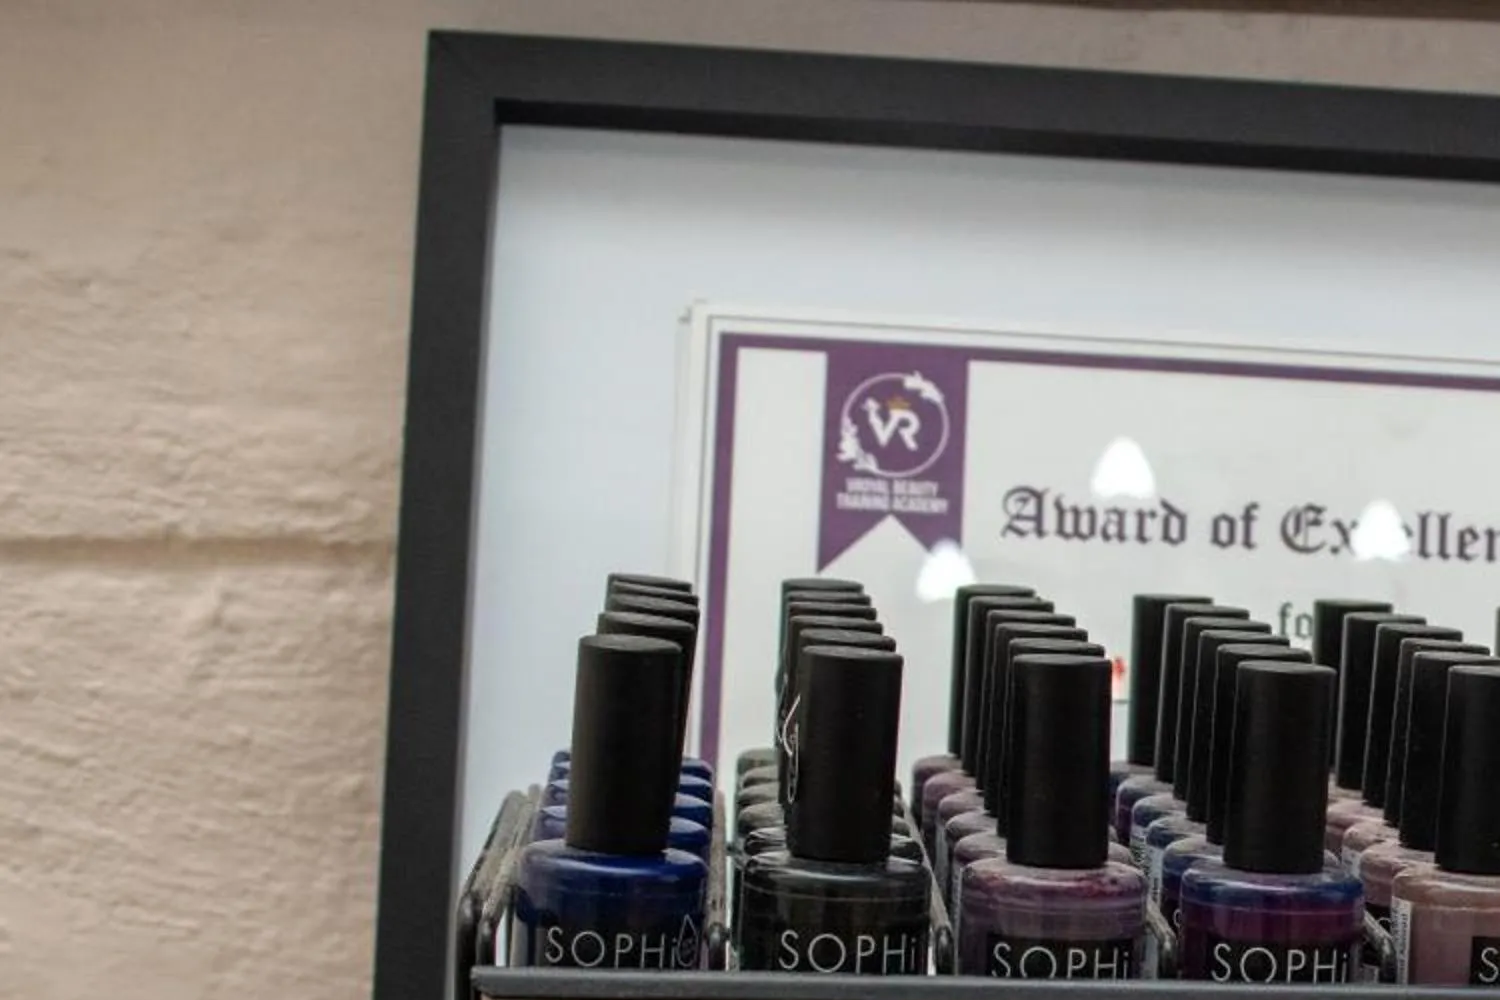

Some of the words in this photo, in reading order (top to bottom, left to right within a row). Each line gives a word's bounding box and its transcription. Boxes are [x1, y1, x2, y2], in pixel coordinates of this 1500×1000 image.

[1000, 485, 1188, 545] Award
[1210, 502, 1260, 549] of
[1278, 601, 1314, 639] fo
[779, 929, 916, 974] SOPHi
[991, 942, 1129, 980] SOPHi
[1211, 943, 1348, 984] SOPHi
